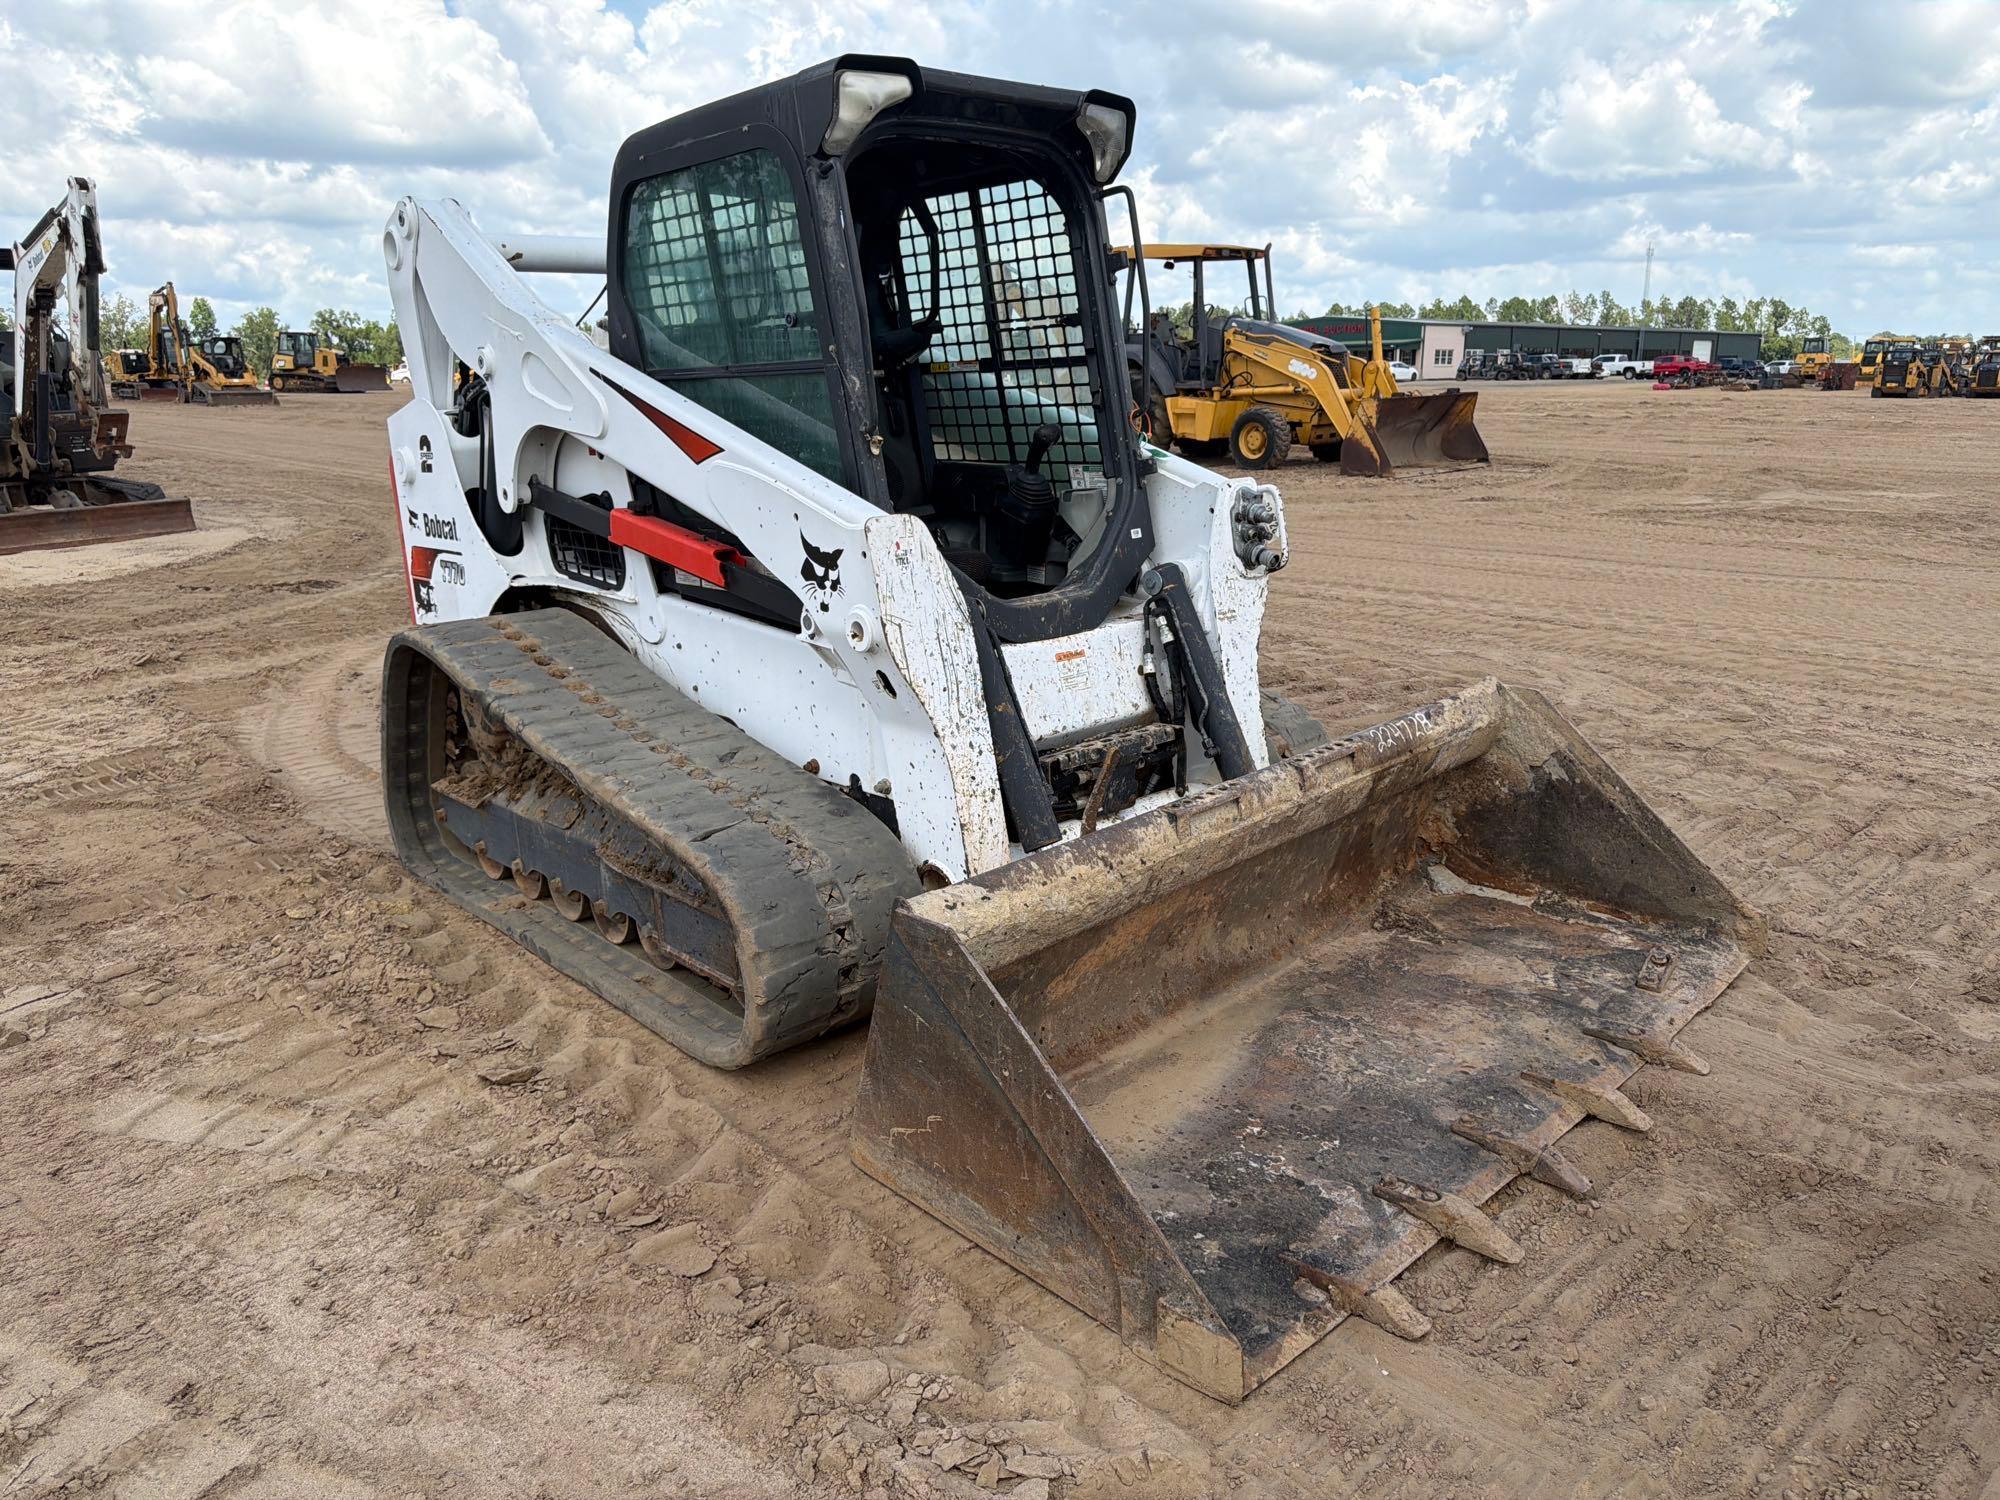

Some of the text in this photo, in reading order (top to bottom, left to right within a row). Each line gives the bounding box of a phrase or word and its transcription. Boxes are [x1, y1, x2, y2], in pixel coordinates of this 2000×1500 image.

[423, 513, 458, 541] Bobcat
[440, 560, 465, 586] T770
[1370, 713, 1433, 753] 224728
